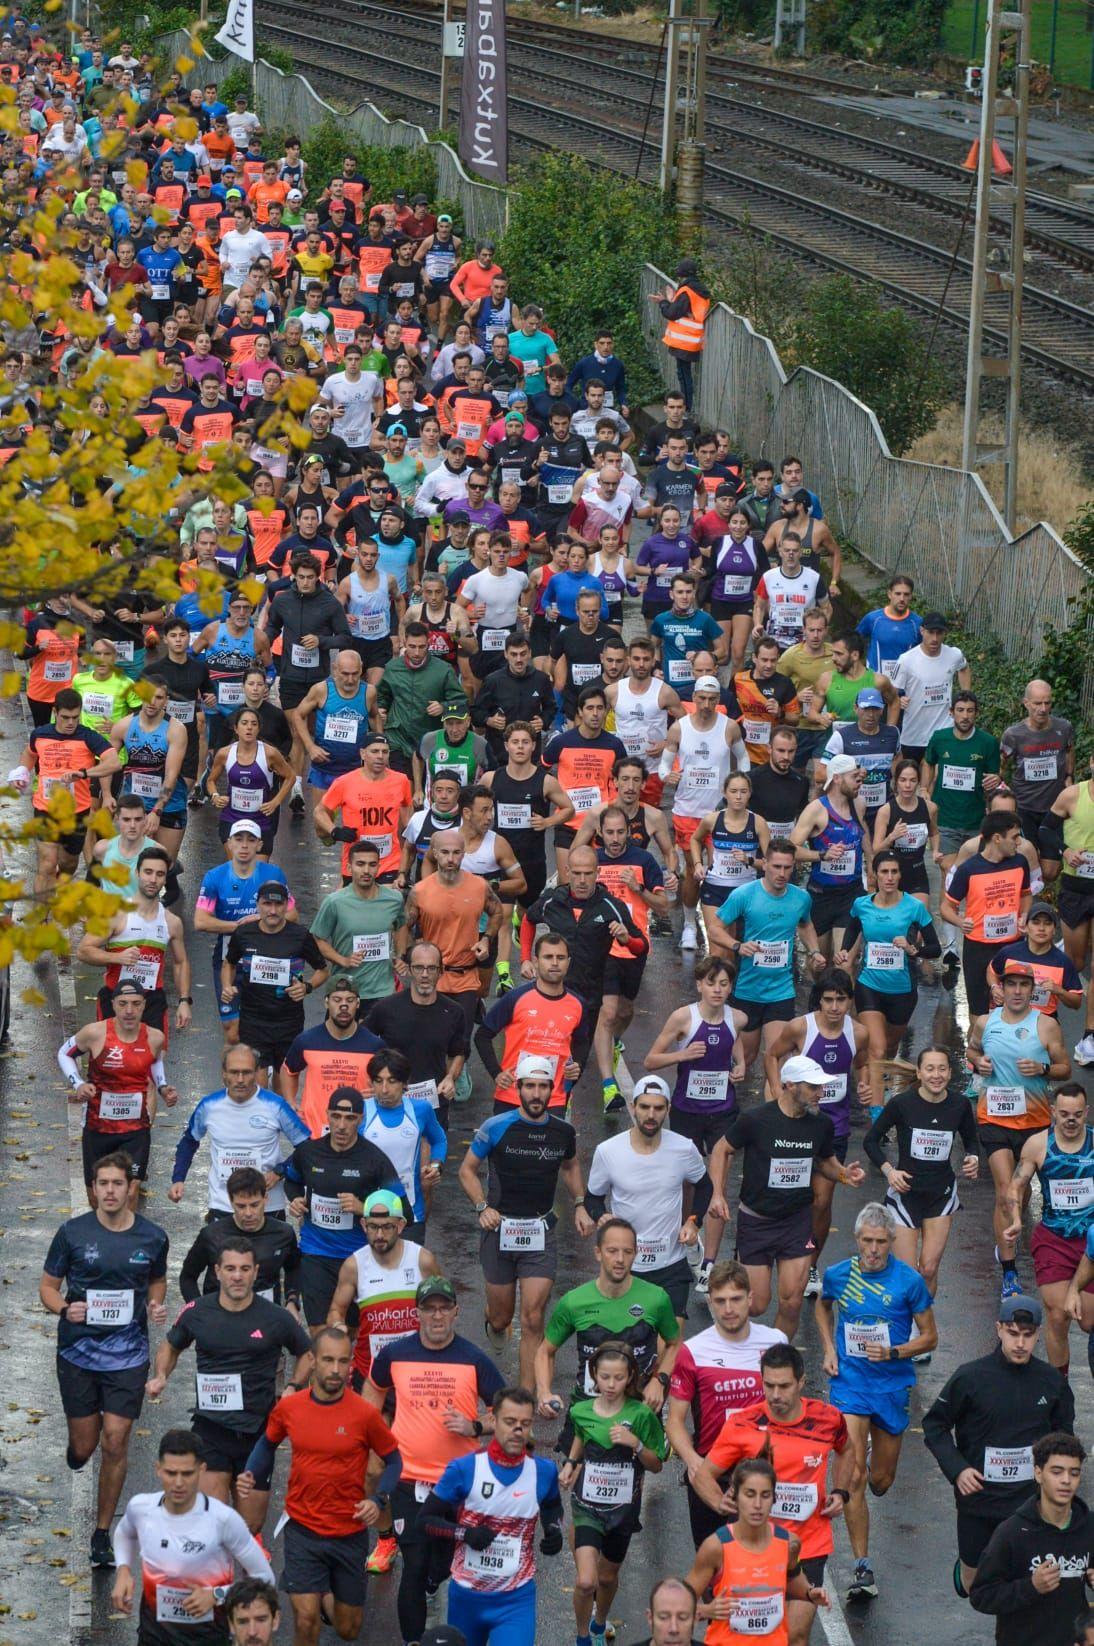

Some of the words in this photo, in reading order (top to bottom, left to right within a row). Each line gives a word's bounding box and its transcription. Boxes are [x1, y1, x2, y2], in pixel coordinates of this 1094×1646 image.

[457, 39, 465, 48] 2
[360, 807, 394, 827] 10K
[261, 971, 279, 980] 2198
[699, 1086, 716, 1094] 2915
[923, 1146, 940, 1156] 1281
[780, 1174, 800, 1182] 2582
[1067, 1196, 1079, 1204] 711
[321, 1214, 341, 1224] 1538
[514, 1236, 531, 1245] 480
[641, 1254, 656, 1262] 275
[102, 1310, 120, 1318] 1737
[713, 1377, 757, 1393] GETXO
[209, 1394, 227, 1404] 1677
[1002, 1466, 1019, 1476] 572
[596, 1486, 619, 1498] 2327
[781, 1502, 801, 1512] 623
[480, 1556, 504, 1568] 1938
[748, 1617, 768, 1628] 866
